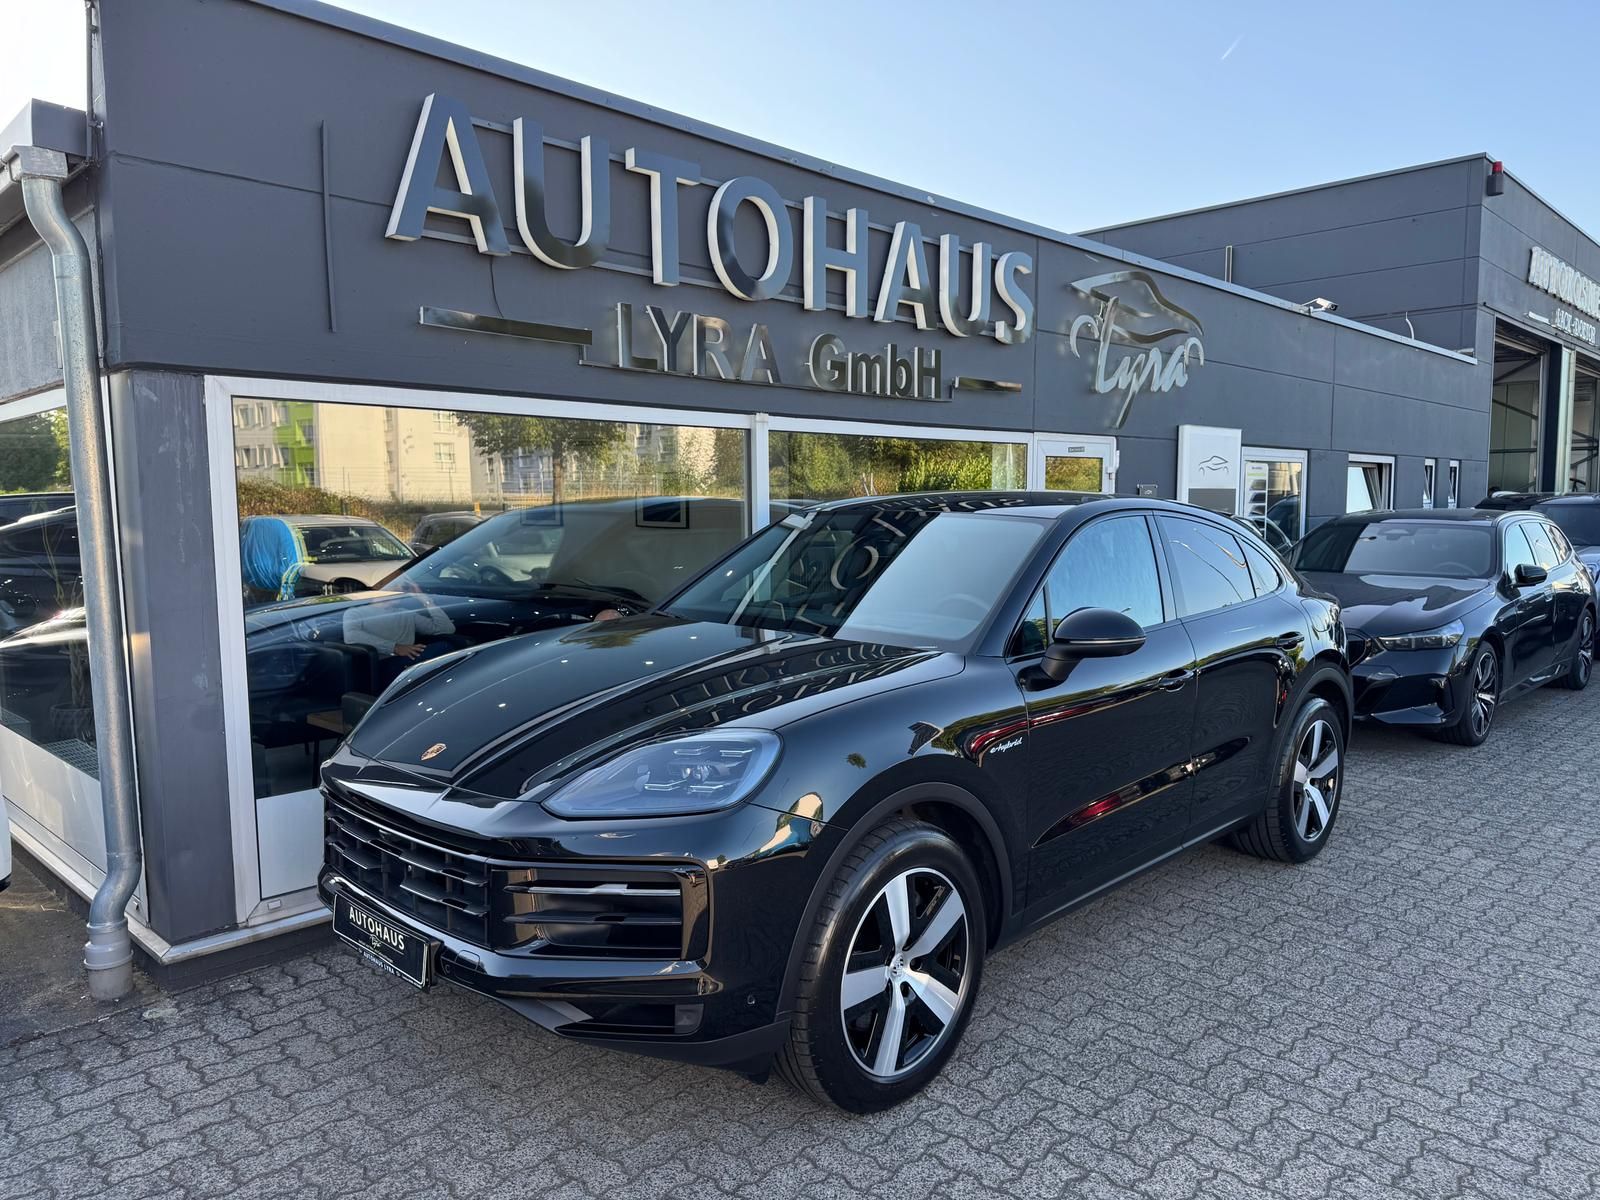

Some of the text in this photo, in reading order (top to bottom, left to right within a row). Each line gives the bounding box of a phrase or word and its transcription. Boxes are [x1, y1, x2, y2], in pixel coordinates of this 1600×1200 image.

[385, 92, 1034, 345] AUTOHAUS
[616, 302, 942, 399] LYRA GmbH
[349, 905, 405, 950] AUTOHAUS
